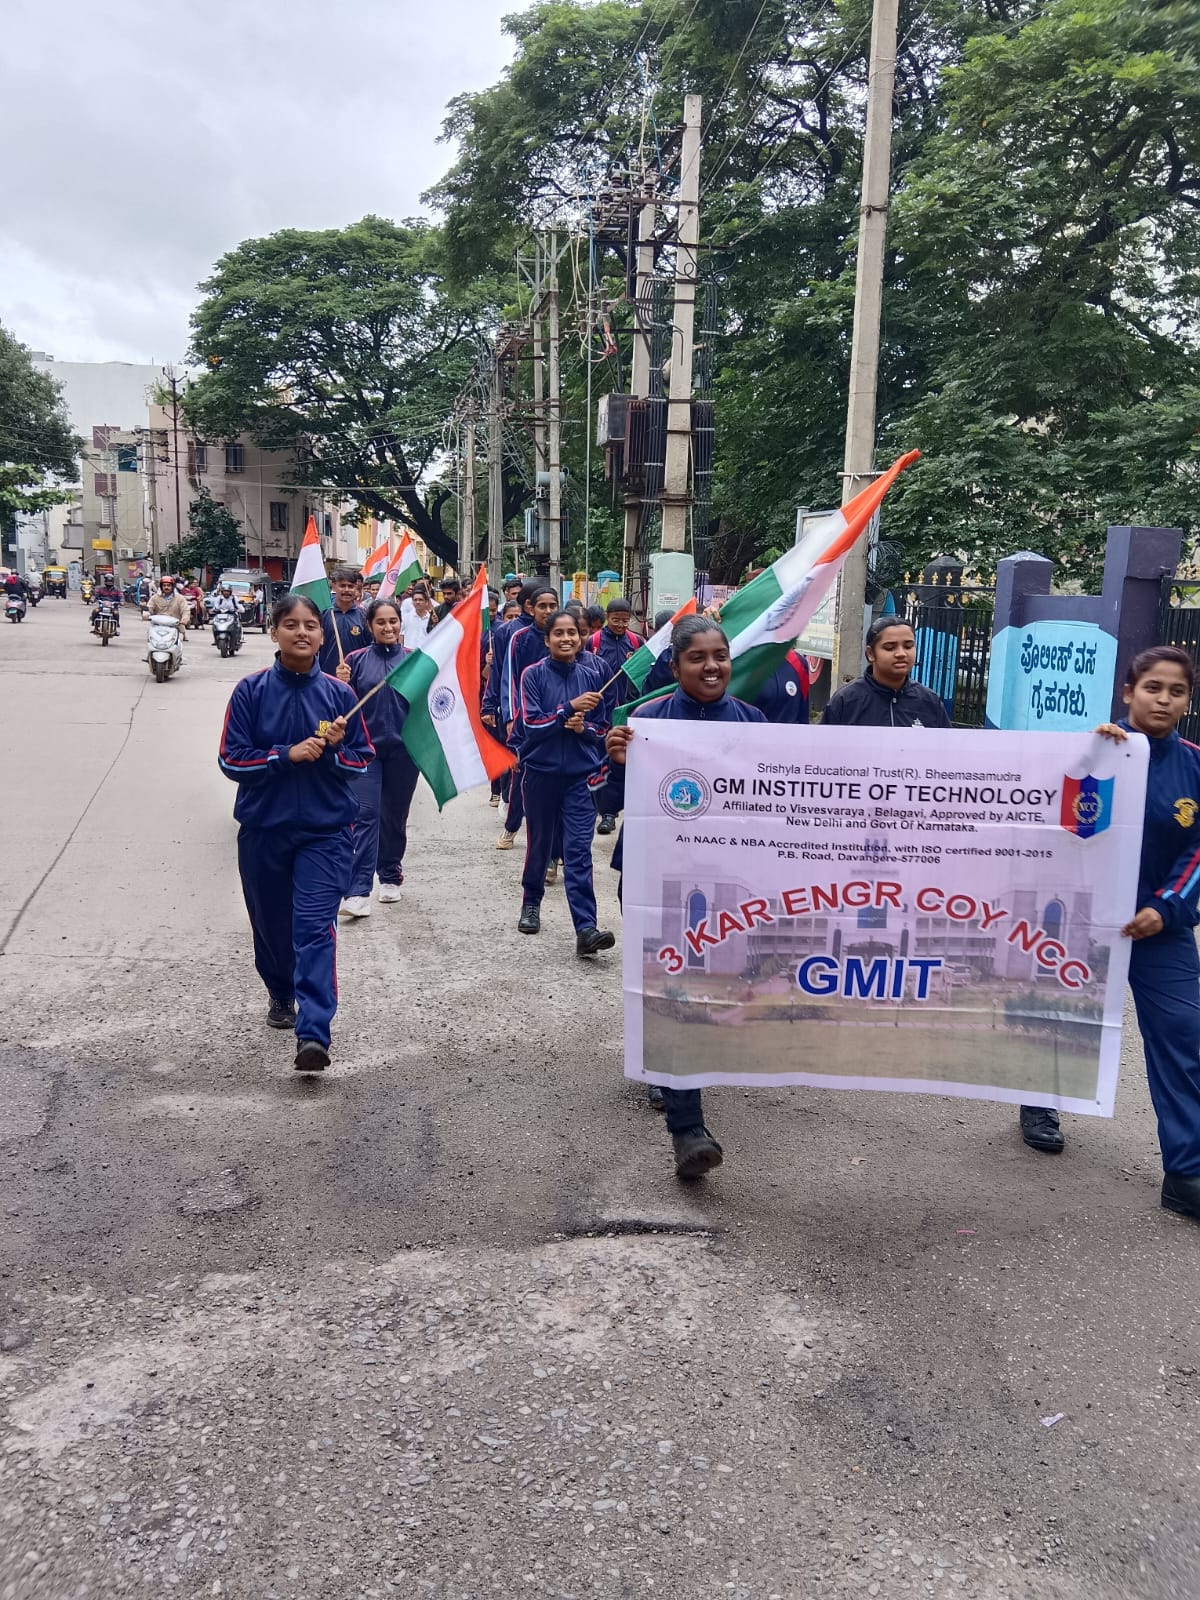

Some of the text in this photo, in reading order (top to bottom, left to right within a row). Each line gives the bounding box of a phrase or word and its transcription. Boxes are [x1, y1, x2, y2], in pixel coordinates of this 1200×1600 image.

[1031, 679, 1088, 719] ಗೃಹಗಳು.
[757, 763, 801, 776] Srishyla
[804, 765, 869, 777] Educational
[925, 769, 1022, 782] Bheemasamudra
[713, 777, 1058, 806] GM INSTITUTE OF TECHNOLOGY
[722, 800, 772, 813] Affiliated
[775, 803, 787, 813] to
[789, 804, 865, 818] Visvesvaraya
[875, 807, 927, 820] Belagavi,
[929, 809, 986, 821] Approved
[989, 811, 1004, 823] by
[1005, 812, 1046, 823] AICTE,
[786, 816, 810, 827] New
[814, 818, 842, 828] Delhi
[845, 819, 867, 828] and
[870, 819, 897, 830] Govt
[900, 820, 913, 830] Of
[675, 834, 691, 843] An
[694, 836, 727, 845] NAAC
[729, 838, 738, 846] &
[741, 839, 766, 847] NBA
[768, 839, 829, 850] Accredited
[894, 845, 919, 854] with
[921, 846, 942, 854] ISO
[945, 846, 992, 856] certified
[994, 848, 1053, 858] 9001-2015
[777, 850, 941, 864] P.B. Road, Davangere-577006
[659, 881, 1090, 988] 3 KAR ENGR COY NCC
[798, 956, 943, 998] GMIT
